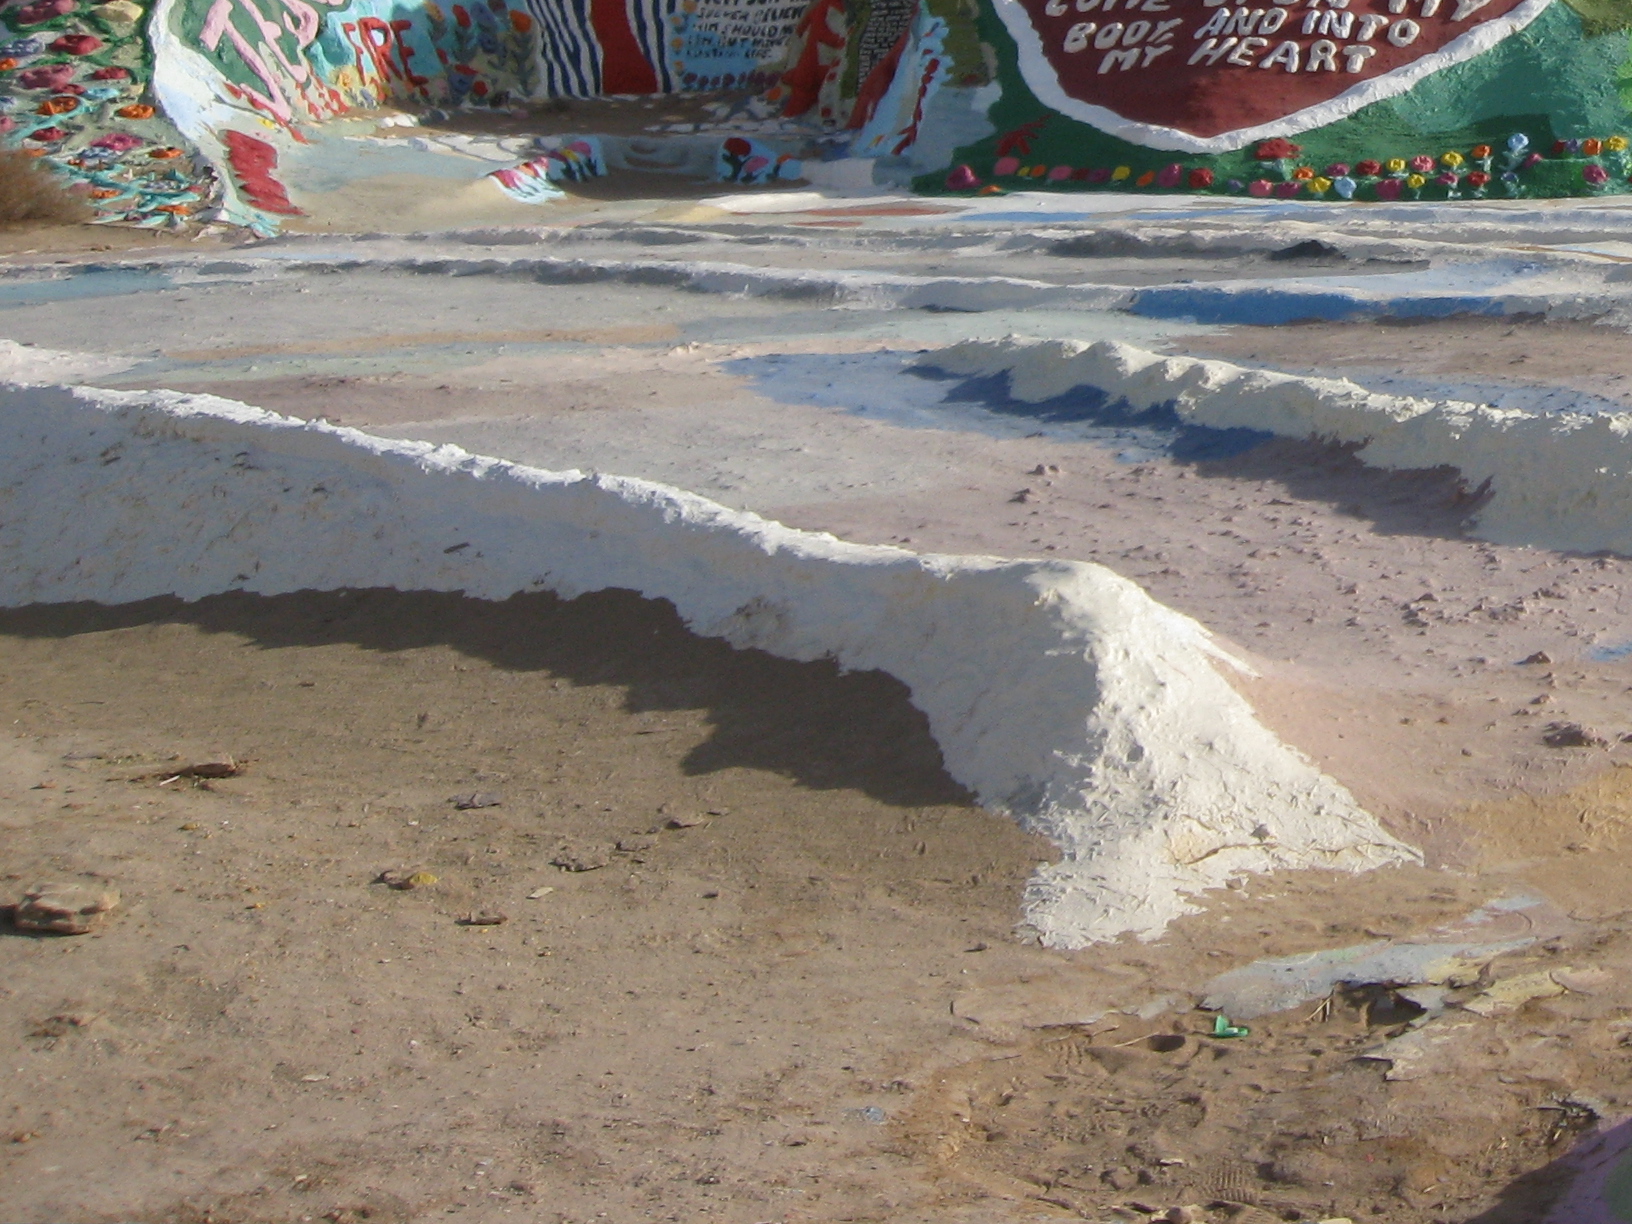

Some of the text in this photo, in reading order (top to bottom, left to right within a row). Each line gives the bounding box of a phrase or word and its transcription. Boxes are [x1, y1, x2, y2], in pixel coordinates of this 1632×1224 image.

[1193, 6, 1289, 40] AND
[1301, 9, 1421, 48] INTO
[1096, 36, 1378, 75] MY HEART
